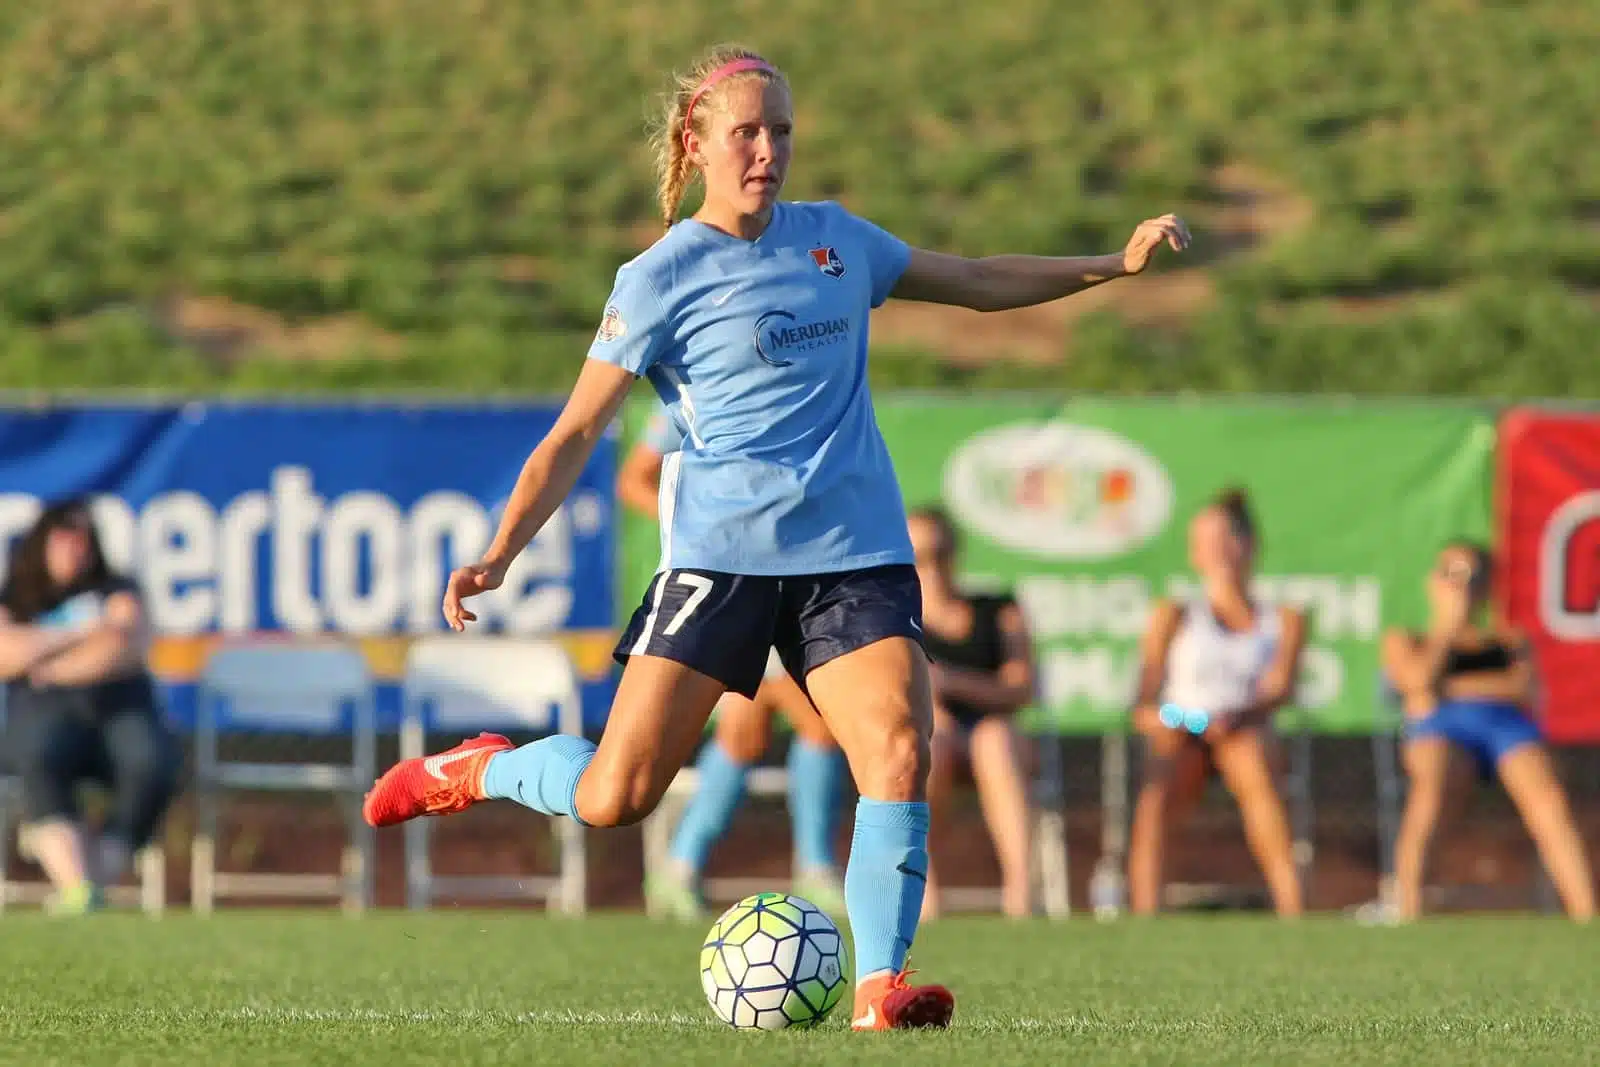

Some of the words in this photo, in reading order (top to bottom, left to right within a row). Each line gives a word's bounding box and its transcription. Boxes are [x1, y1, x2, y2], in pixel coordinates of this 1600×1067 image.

[768, 317, 850, 351] MERIDIAN
[797, 333, 849, 353] HEALTH
[662, 573, 714, 636] 7
